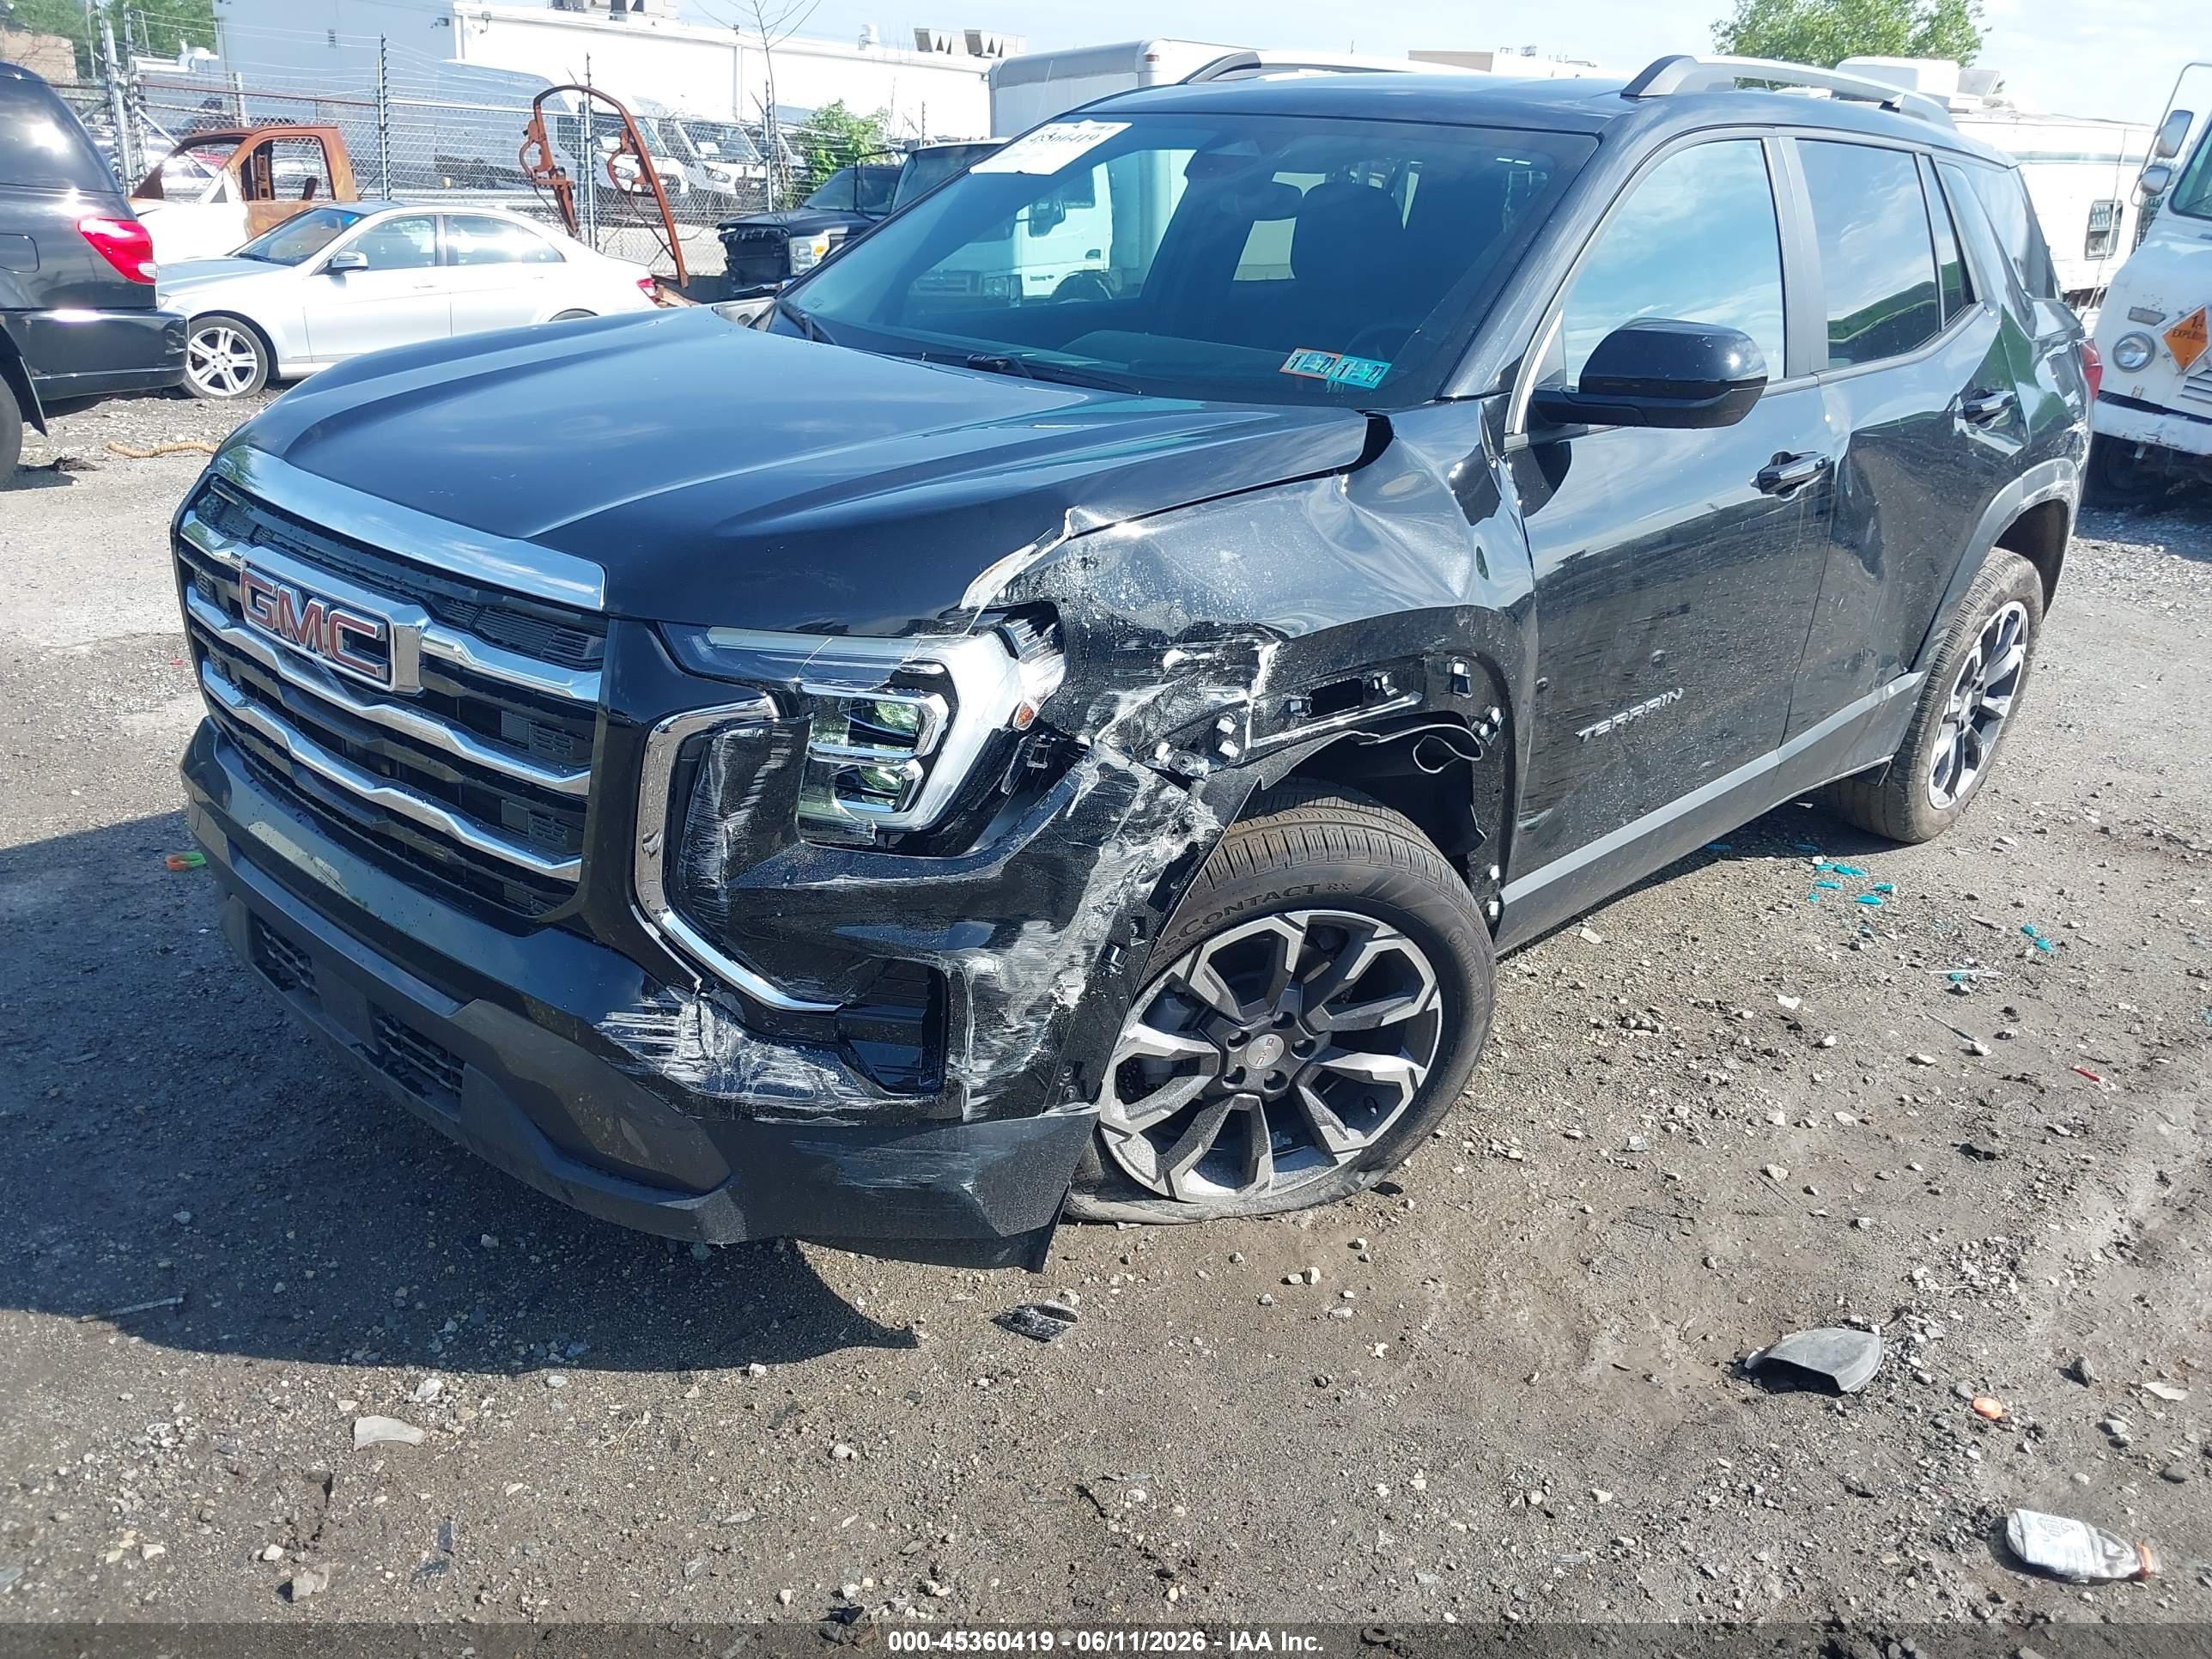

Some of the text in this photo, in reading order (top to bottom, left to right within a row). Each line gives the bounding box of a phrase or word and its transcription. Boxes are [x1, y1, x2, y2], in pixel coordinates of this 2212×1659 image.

[240, 568, 386, 680] GMC
[1574, 687, 1684, 743] TERRAIN
[1151, 882, 1320, 963] SSCONTACT
